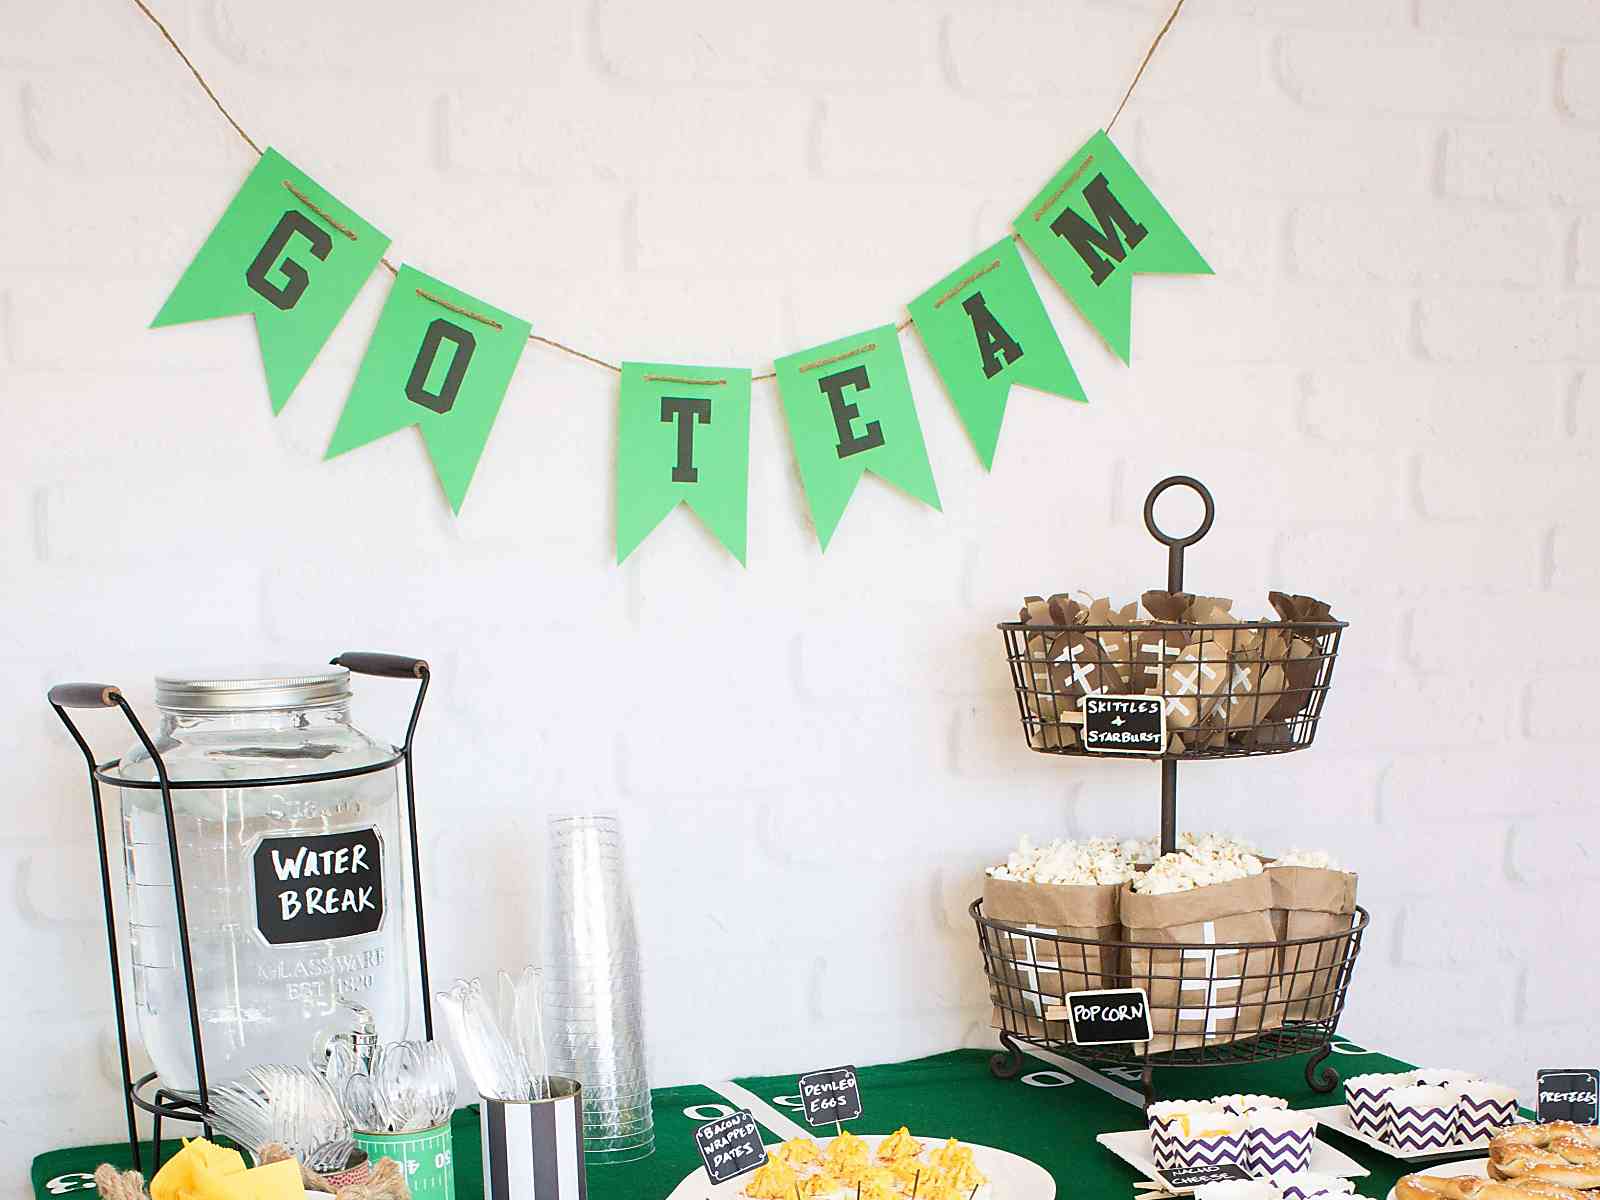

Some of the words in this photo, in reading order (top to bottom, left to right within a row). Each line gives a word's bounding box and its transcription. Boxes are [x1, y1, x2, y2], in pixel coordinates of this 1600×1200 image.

[1088, 701, 1158, 714] SKITTLES
[1088, 730, 1161, 743] STARBURST
[271, 844, 370, 880] WATER
[278, 886, 375, 920] BREAK
[1074, 1003, 1143, 1023] POPCORN
[804, 1078, 855, 1098] DEVILED
[1540, 1091, 1597, 1105] PRETZELS
[810, 1095, 847, 1112] EGGS
[703, 1116, 740, 1140] BACON
[704, 1123, 754, 1155] WRAPPED
[713, 1142, 754, 1167] DATES
[1171, 1172, 1235, 1184] CHEESE
[1172, 1166, 1220, 1177] NACHO
